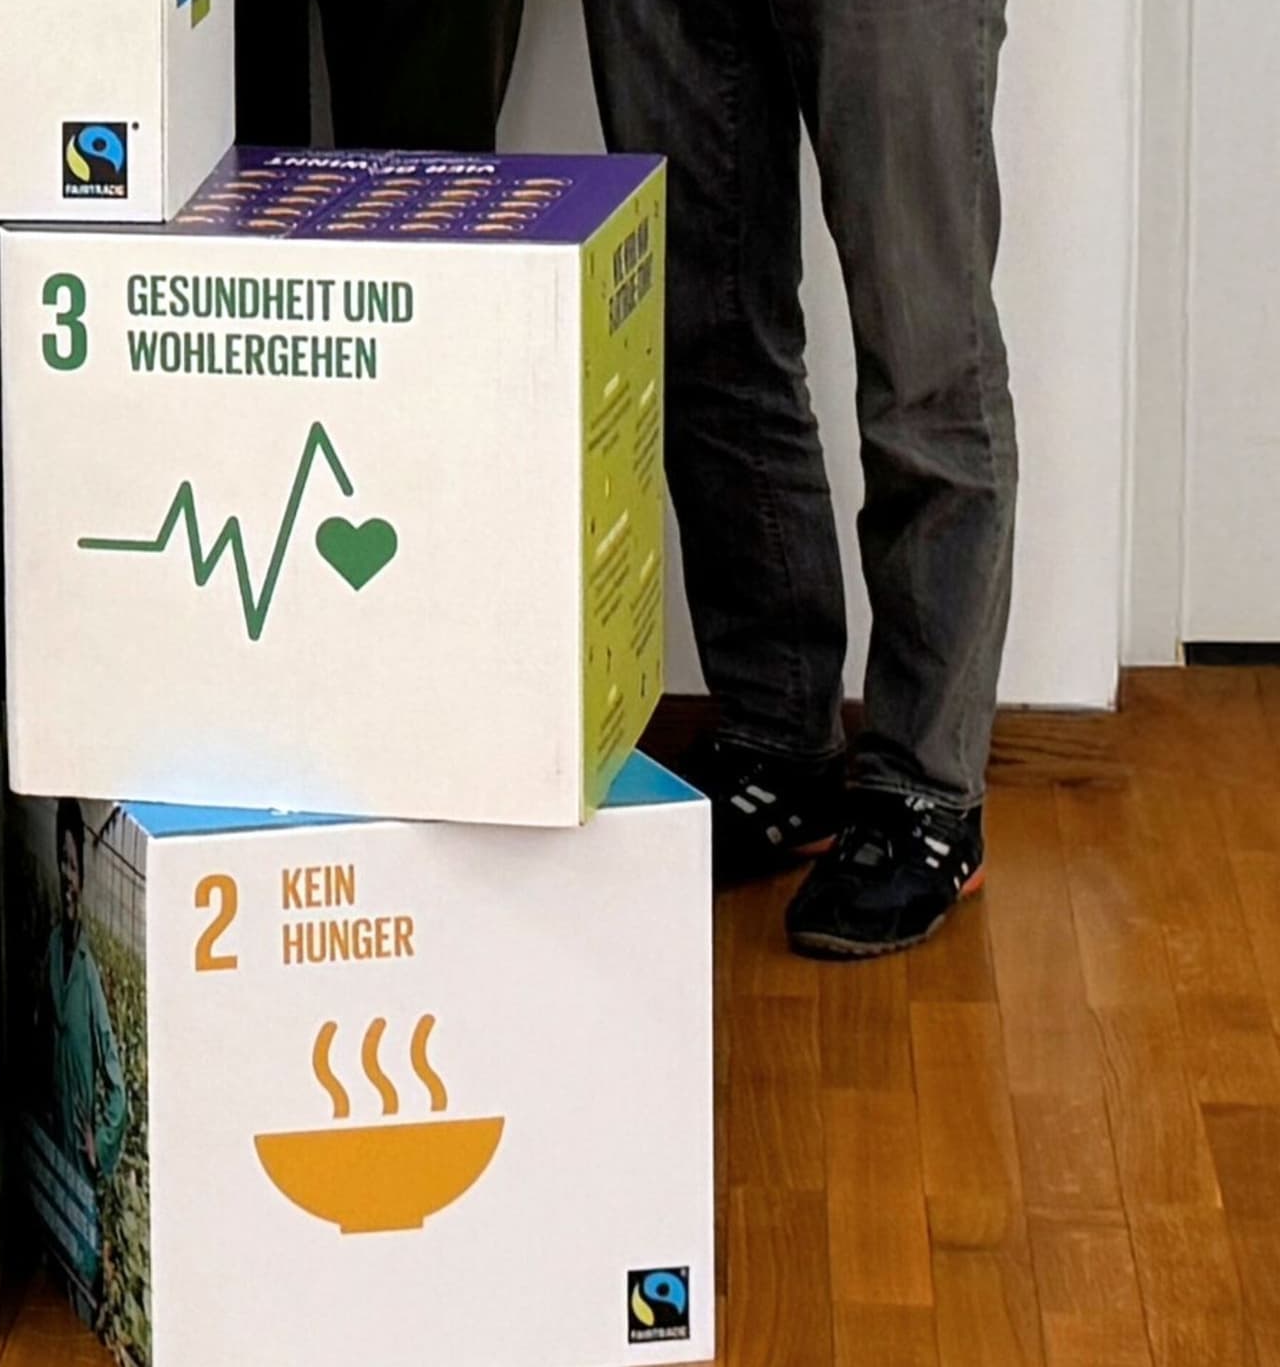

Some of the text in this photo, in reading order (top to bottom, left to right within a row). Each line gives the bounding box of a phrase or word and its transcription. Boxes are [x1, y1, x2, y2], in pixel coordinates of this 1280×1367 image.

[42, 273, 87, 371] 3
[128, 275, 413, 323] GESUNDHEIT UND
[127, 330, 376, 379] WOHLERGEHEN
[283, 865, 355, 909] KEIN
[195, 874, 238, 972] 2
[283, 916, 413, 964] HUNGER
